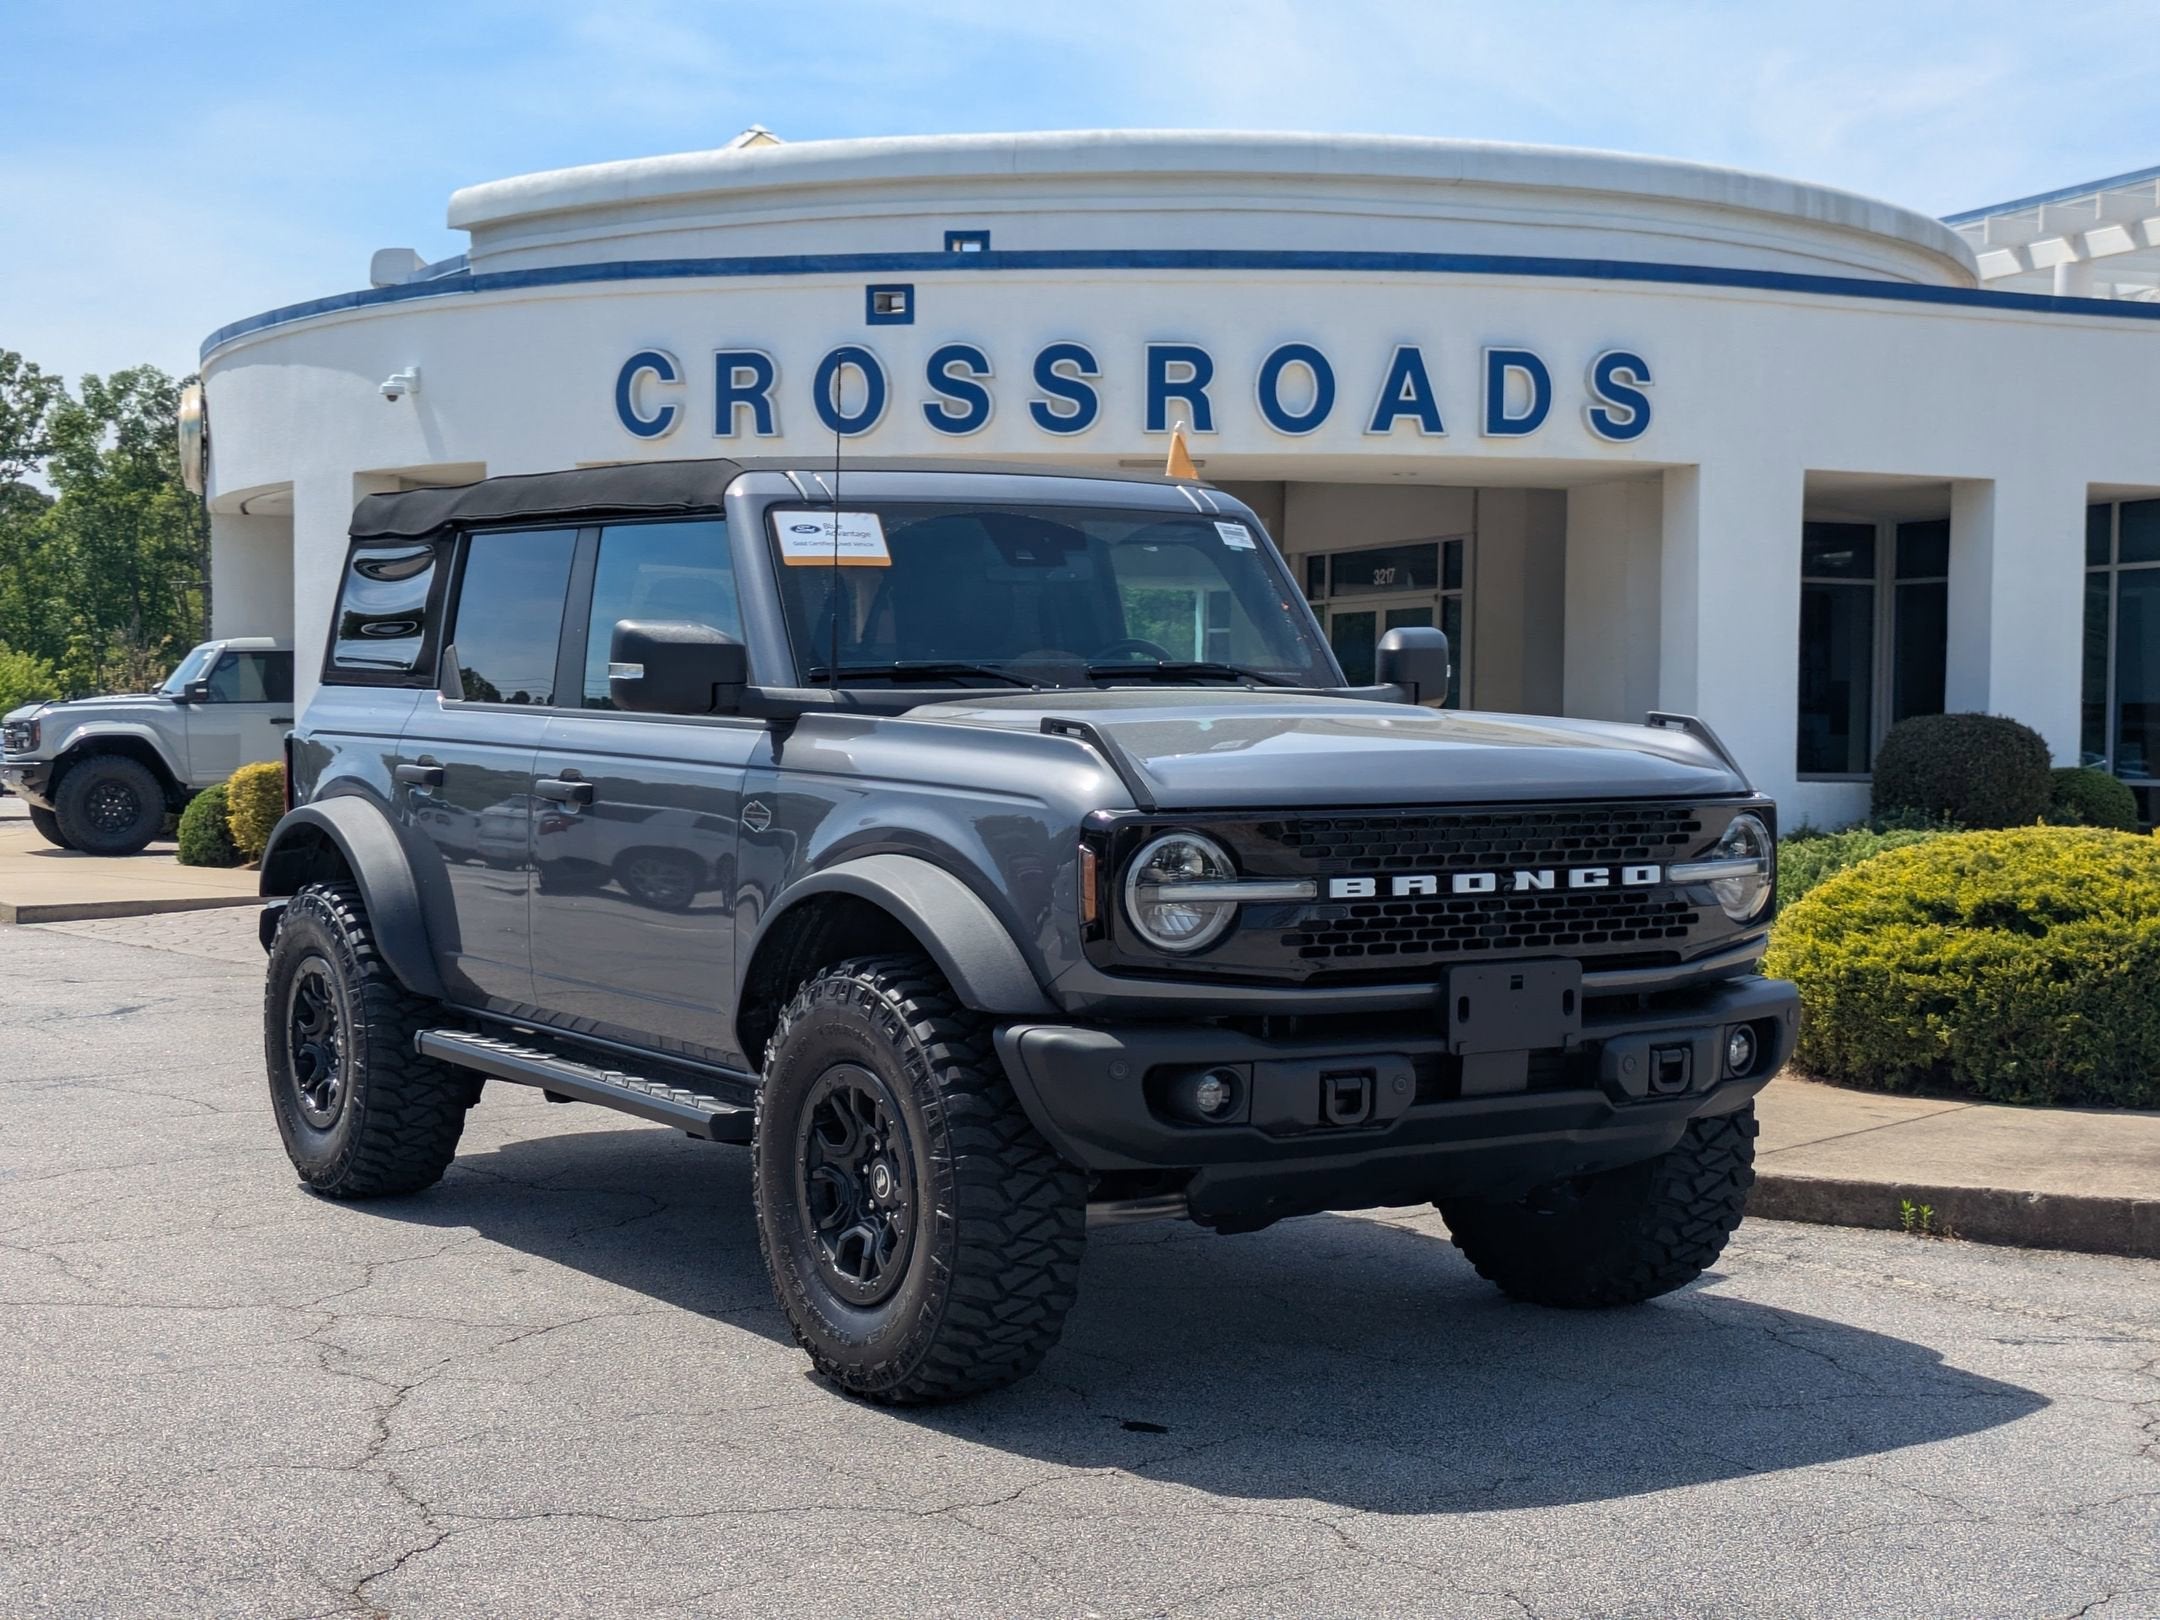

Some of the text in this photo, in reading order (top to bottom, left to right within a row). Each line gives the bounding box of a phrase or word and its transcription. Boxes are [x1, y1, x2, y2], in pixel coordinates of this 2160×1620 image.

[614, 342, 1654, 442] CROSSROADS
[1373, 567, 1396, 586] 3217
[1329, 864, 1662, 899] BRONCO
